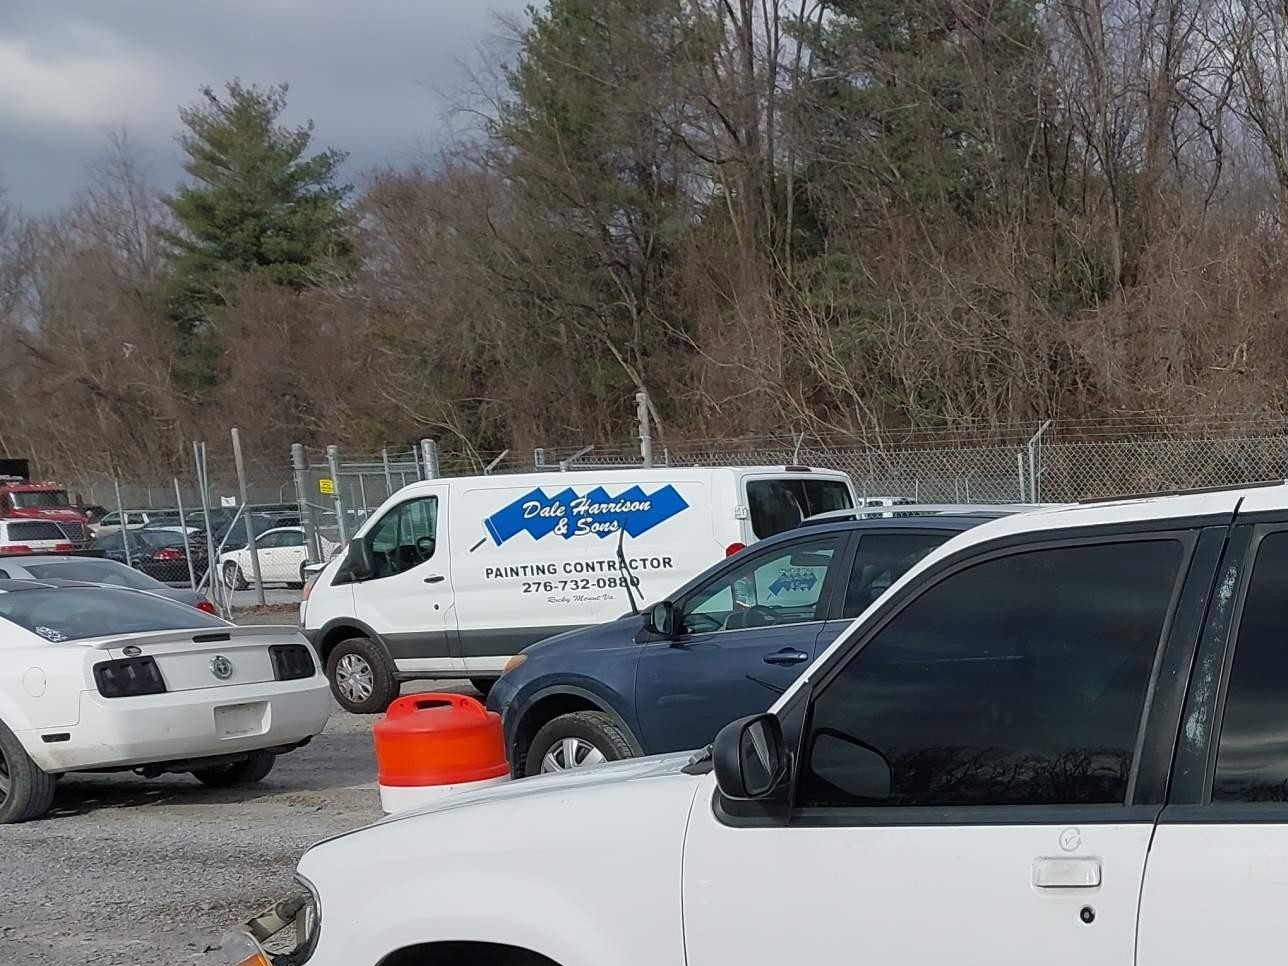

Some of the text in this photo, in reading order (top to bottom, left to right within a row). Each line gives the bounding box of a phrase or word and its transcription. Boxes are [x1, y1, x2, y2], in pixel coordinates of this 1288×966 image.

[522, 497, 652, 519] Dale Harrison
[554, 517, 619, 535] & Sons
[485, 557, 674, 579] PAINTING CONTRACTOR
[521, 576, 641, 593] 276-732-0880
[573, 594, 601, 602] Mount
